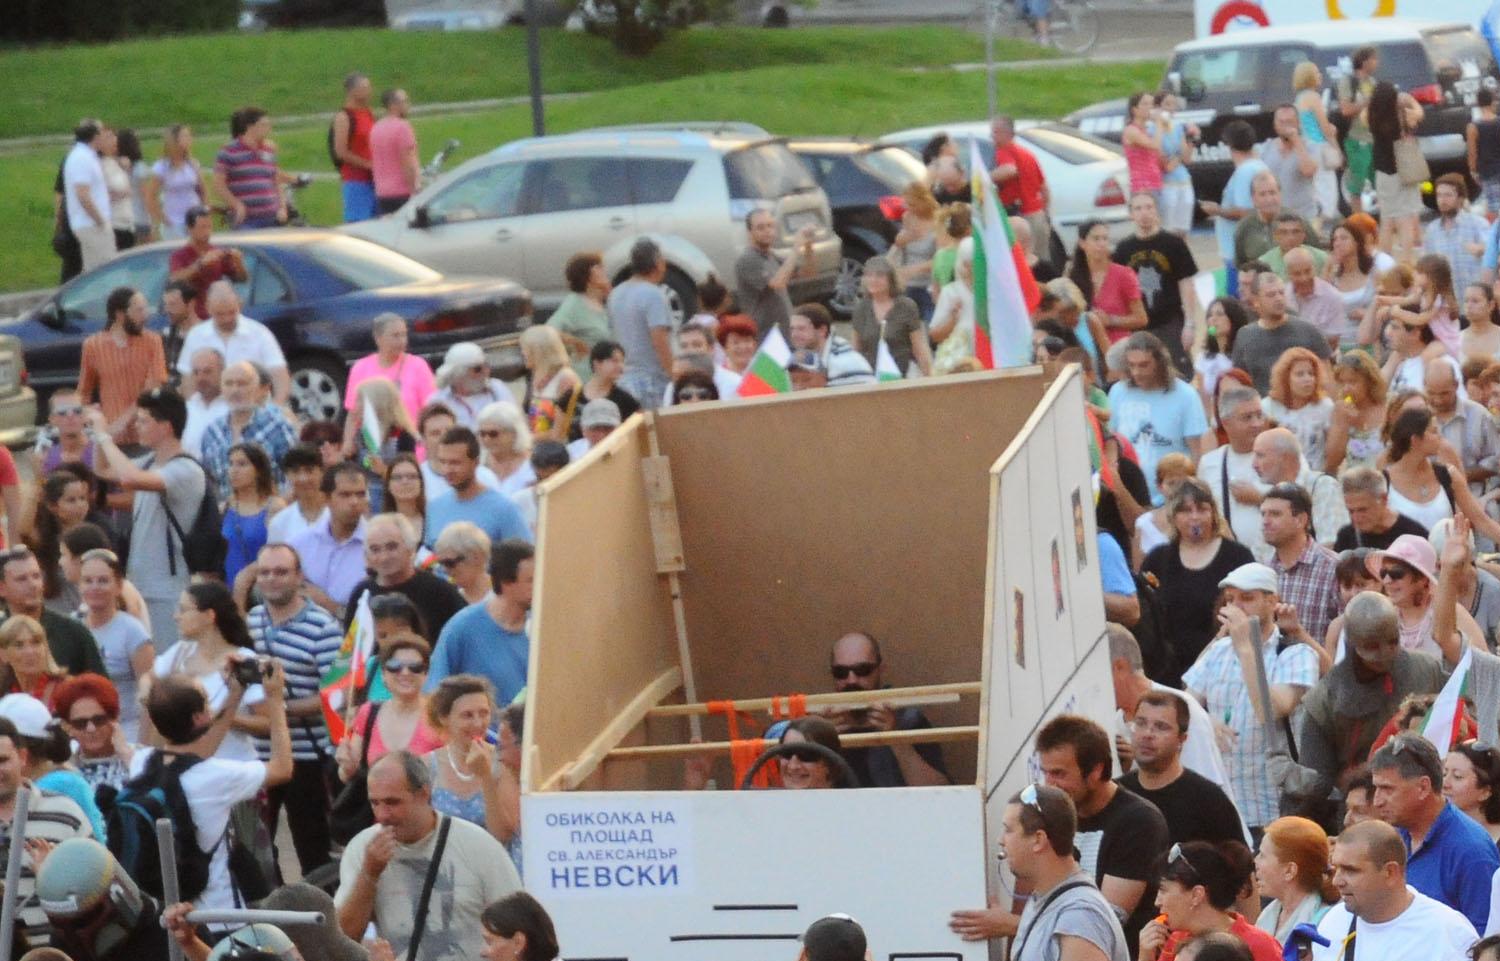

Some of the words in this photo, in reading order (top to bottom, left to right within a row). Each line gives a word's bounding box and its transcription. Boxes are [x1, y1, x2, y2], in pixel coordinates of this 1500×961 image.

[545, 811, 646, 826] ОБИКОЛКА
[651, 811, 675, 824] НА
[570, 829, 654, 844] ПЛОЩАД
[547, 850, 571, 862] СВ.
[576, 848, 677, 862] АЛЕКСАНДЪР
[551, 864, 679, 888] НЕВСКИ
